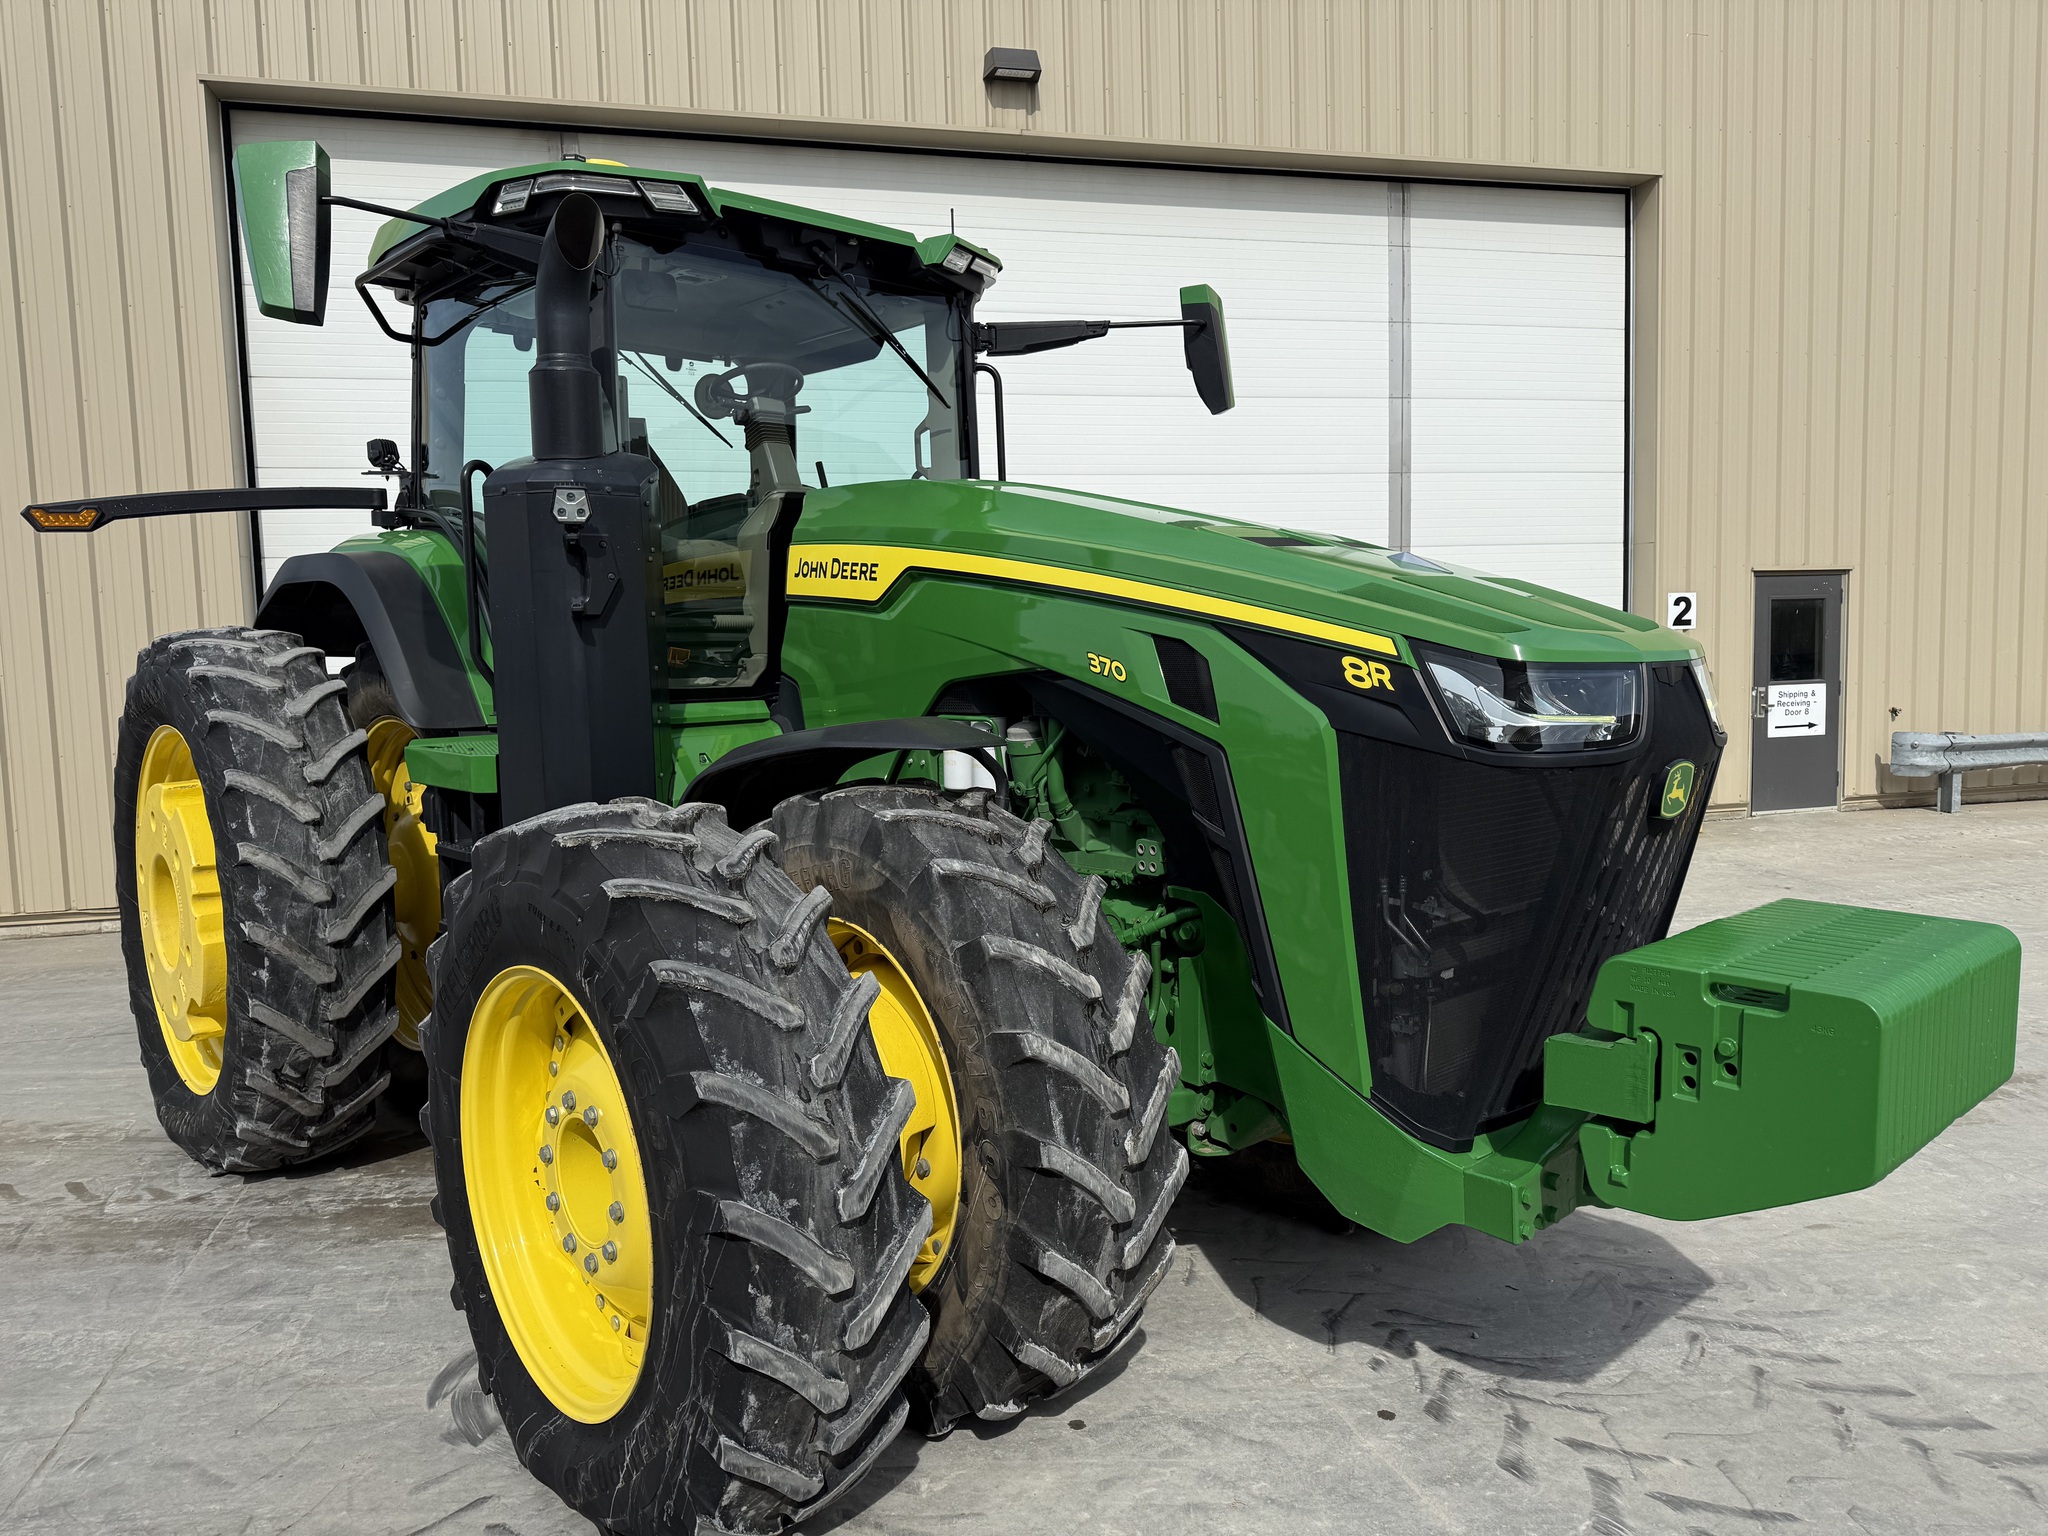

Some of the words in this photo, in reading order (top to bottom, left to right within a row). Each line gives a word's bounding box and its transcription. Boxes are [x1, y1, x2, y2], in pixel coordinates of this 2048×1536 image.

[793, 557, 829, 579] JOHN
[830, 557, 879, 582] DEERE
[1672, 596, 1692, 627] 2
[1087, 652, 1127, 682] 370
[1341, 655, 1395, 692] 8R
[1776, 700, 1811, 708] Receiving
[1778, 690, 1809, 699] Shipping
[1811, 689, 1816, 697] &
[1784, 708, 1802, 716] Door
